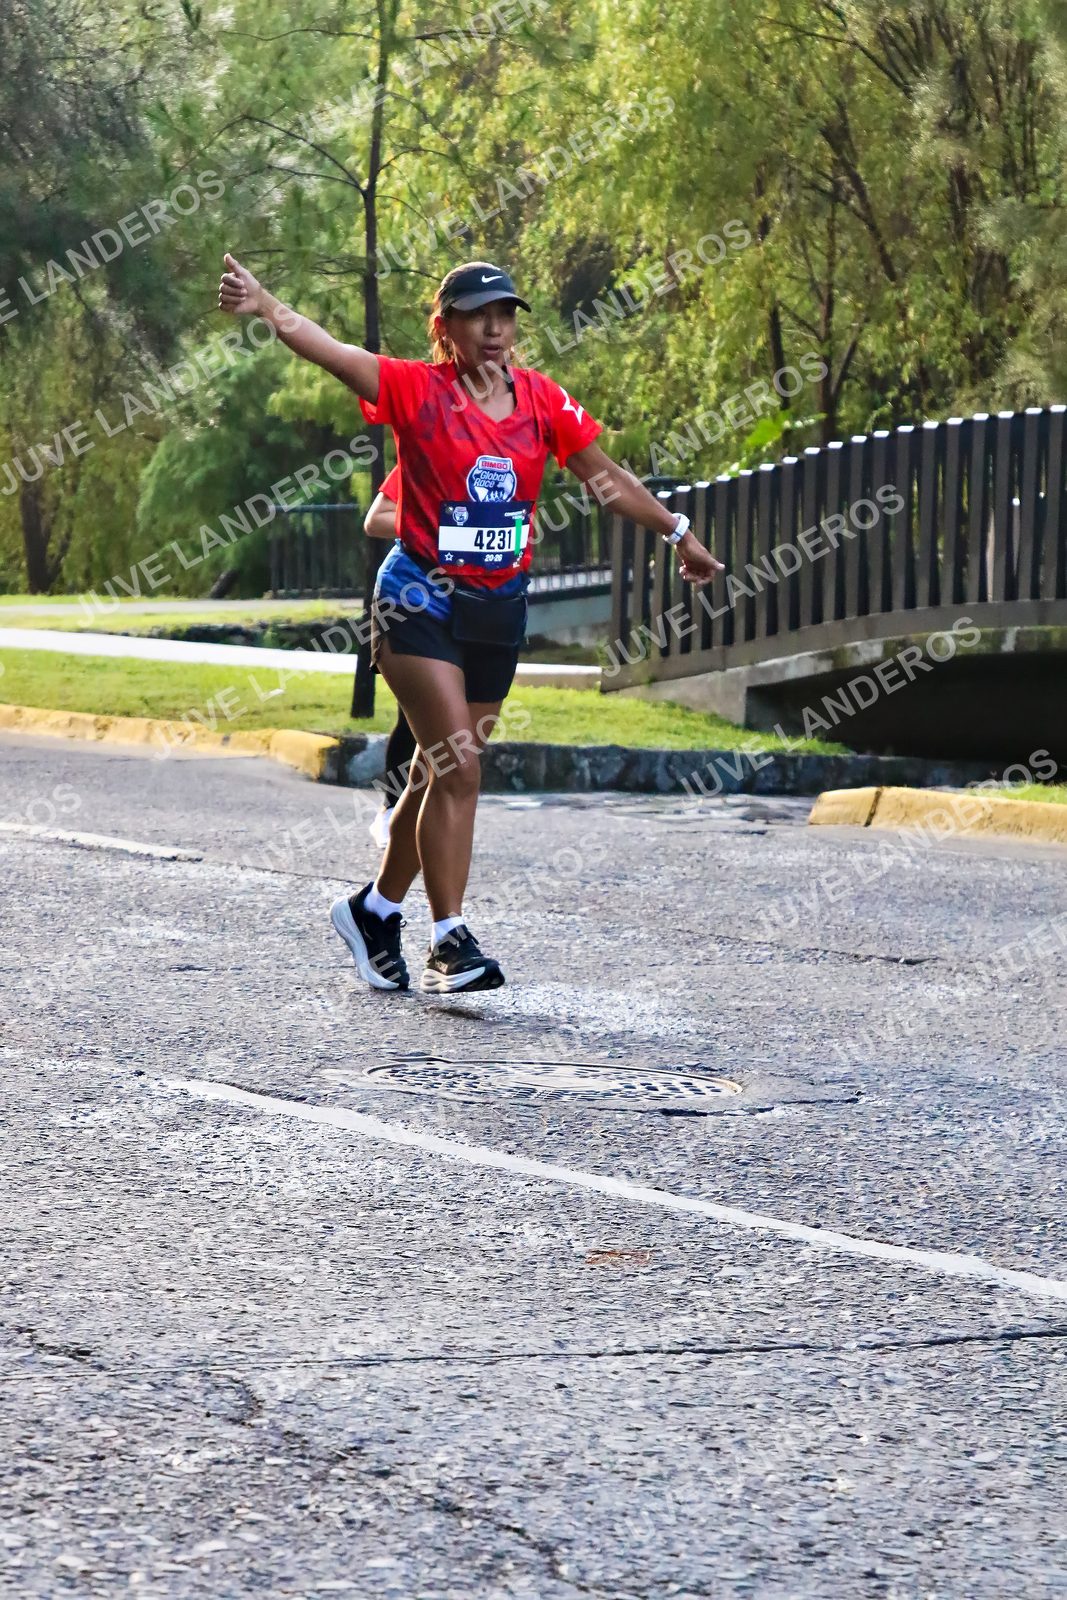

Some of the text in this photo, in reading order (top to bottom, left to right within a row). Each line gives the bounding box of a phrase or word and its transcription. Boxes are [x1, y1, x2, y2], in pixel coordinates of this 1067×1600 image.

[480, 471, 506, 482] Global
[474, 478, 495, 488] Race
[474, 529, 512, 550] 4231
